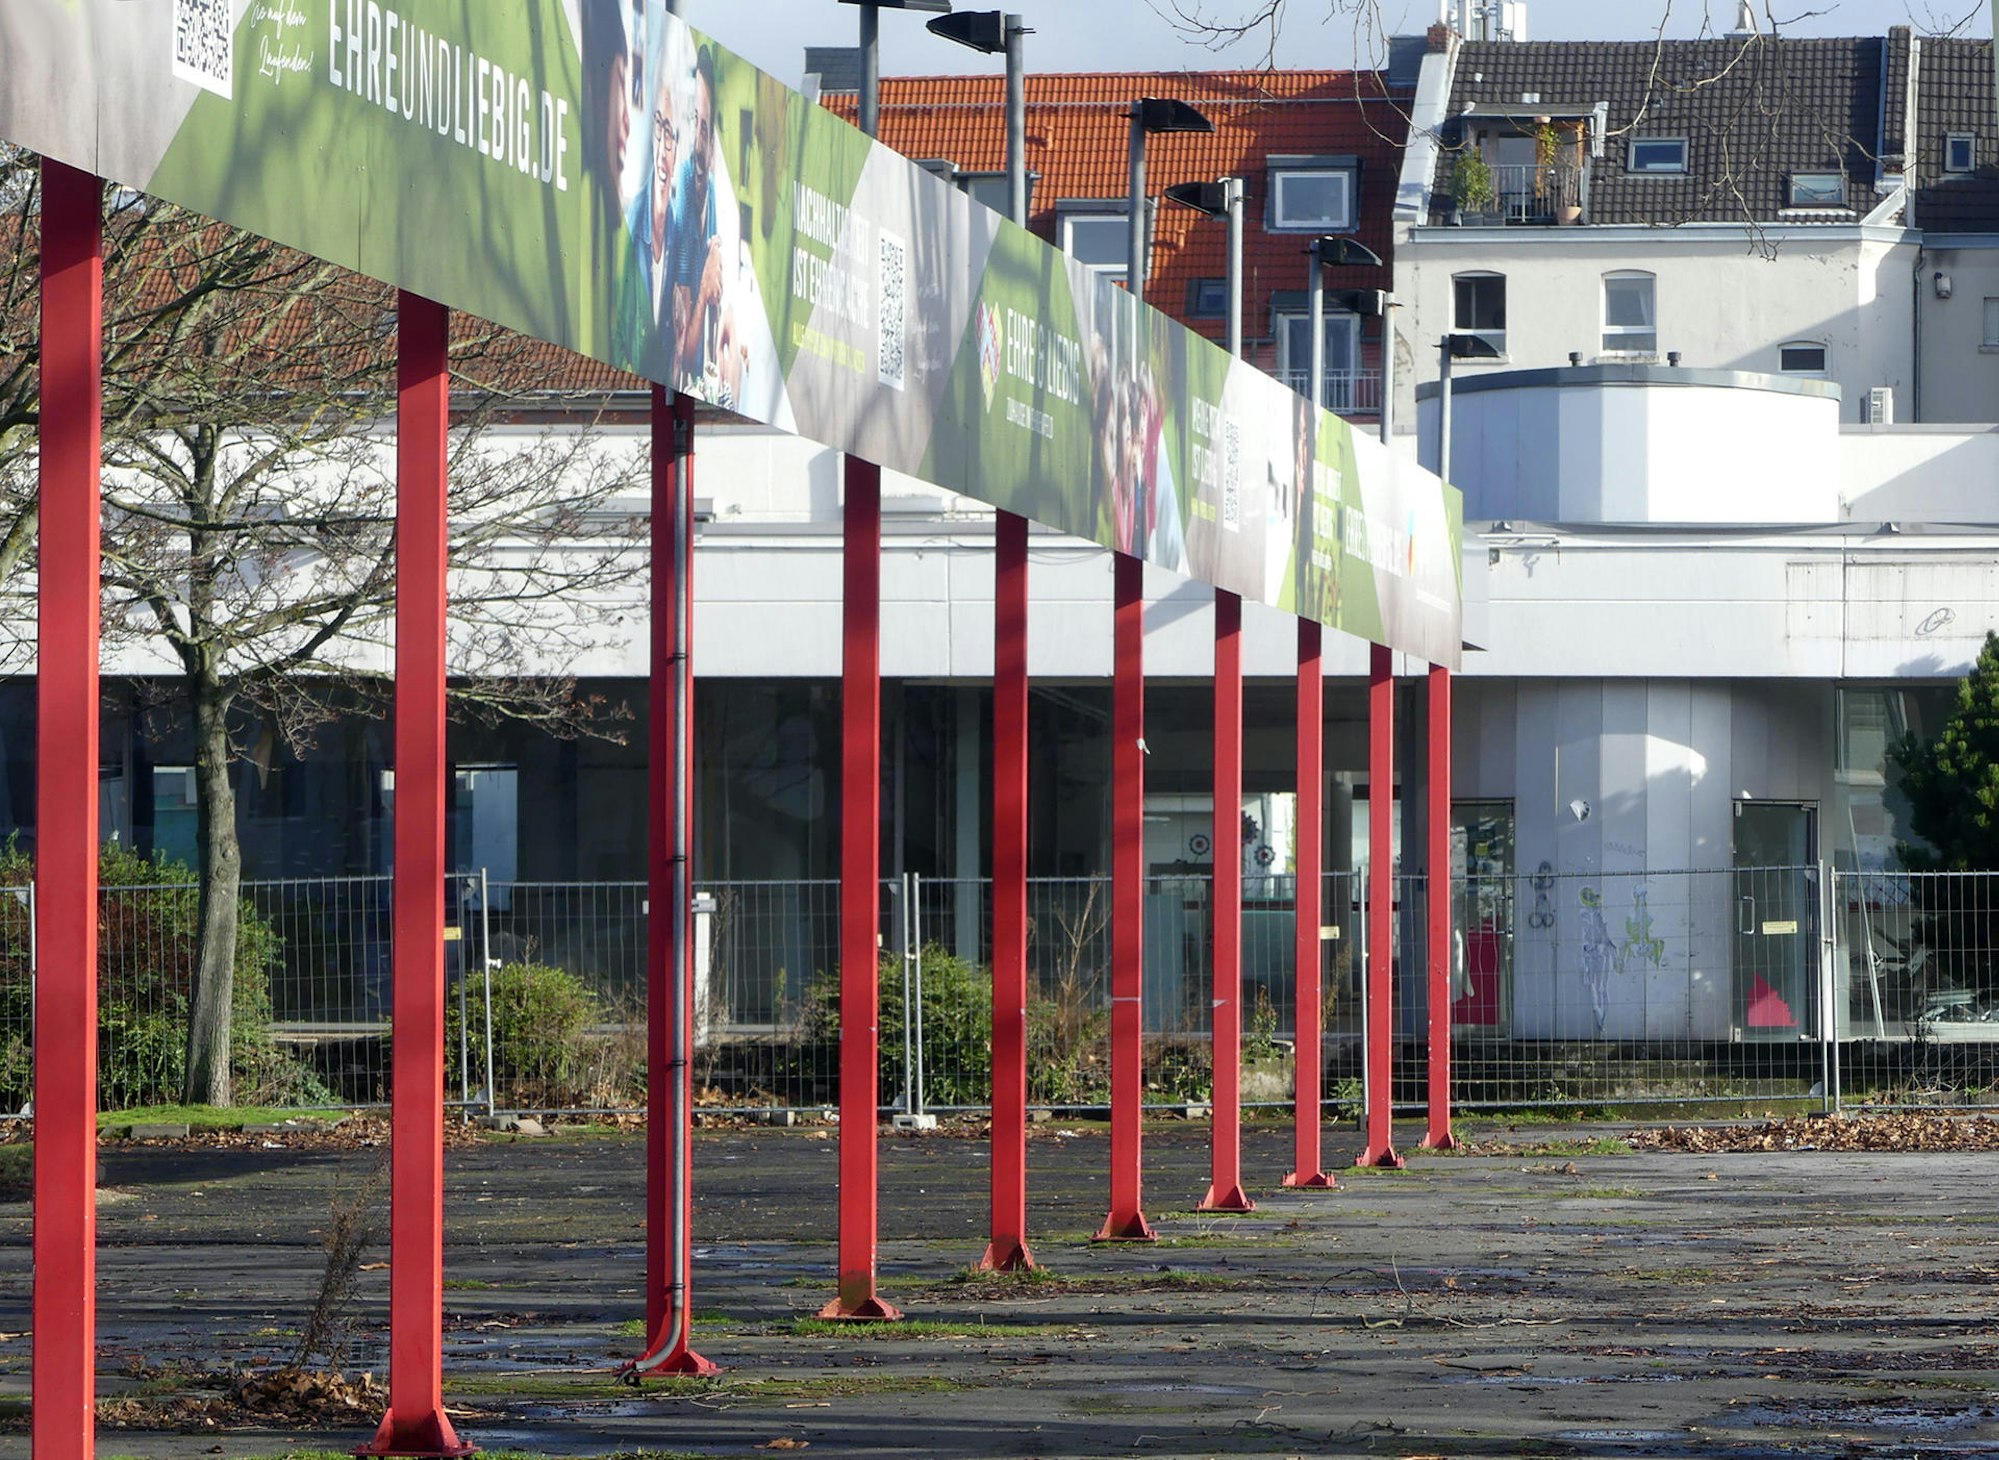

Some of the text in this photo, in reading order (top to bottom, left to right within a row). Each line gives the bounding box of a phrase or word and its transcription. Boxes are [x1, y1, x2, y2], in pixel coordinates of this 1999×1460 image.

[259, 34, 314, 85] Laufenden!
[329, 0, 568, 192] EHREUNDLIEBIG.DE
[793, 246, 808, 300] IST
[1007, 307, 1035, 385] EHRE
[1037, 323, 1045, 389] &
[1047, 329, 1080, 405] LIEBIG
